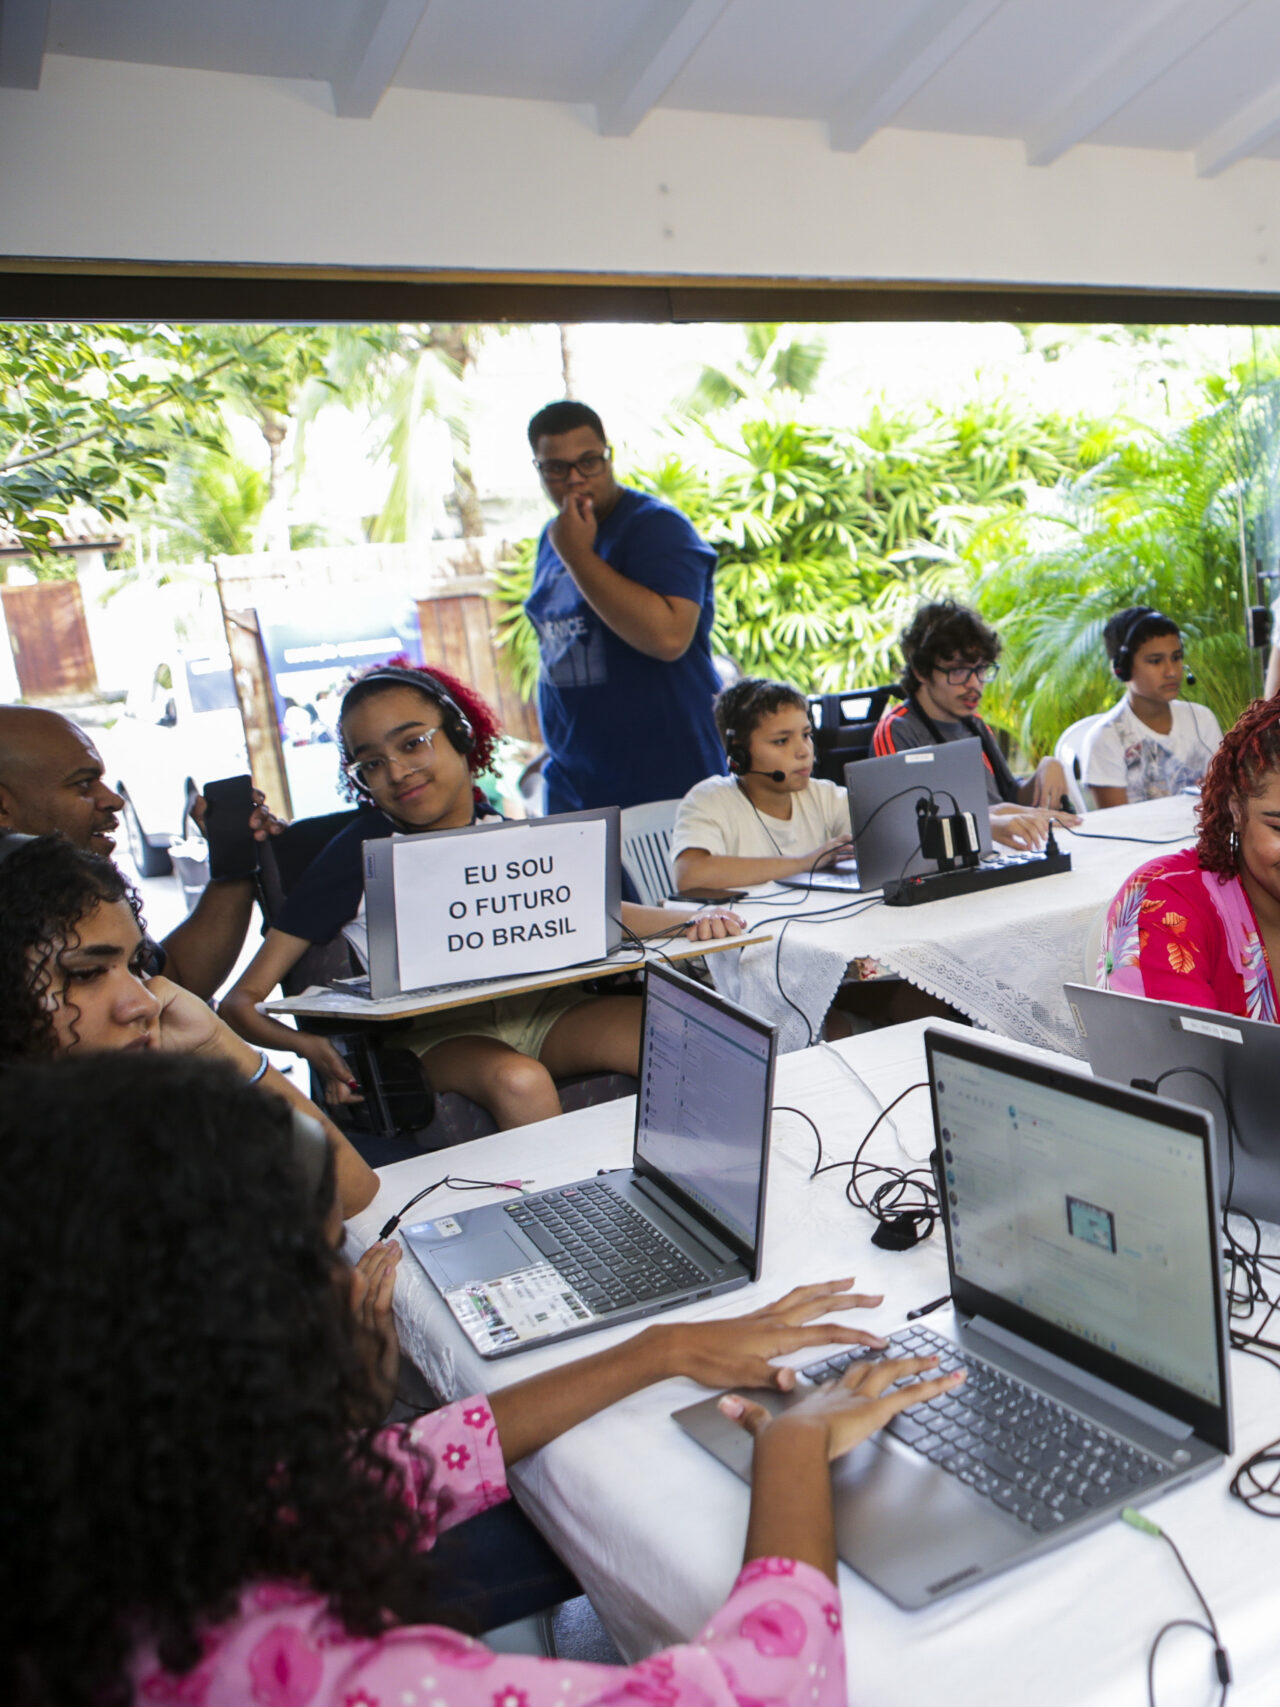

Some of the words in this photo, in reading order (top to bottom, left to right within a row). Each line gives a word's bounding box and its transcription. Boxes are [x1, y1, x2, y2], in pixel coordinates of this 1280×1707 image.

[464, 864, 497, 885] EU
[506, 855, 553, 880] SOU
[449, 901, 467, 919] O
[475, 885, 571, 917] FUTURO
[447, 931, 484, 953] DO
[492, 916, 577, 947] BRASIL
